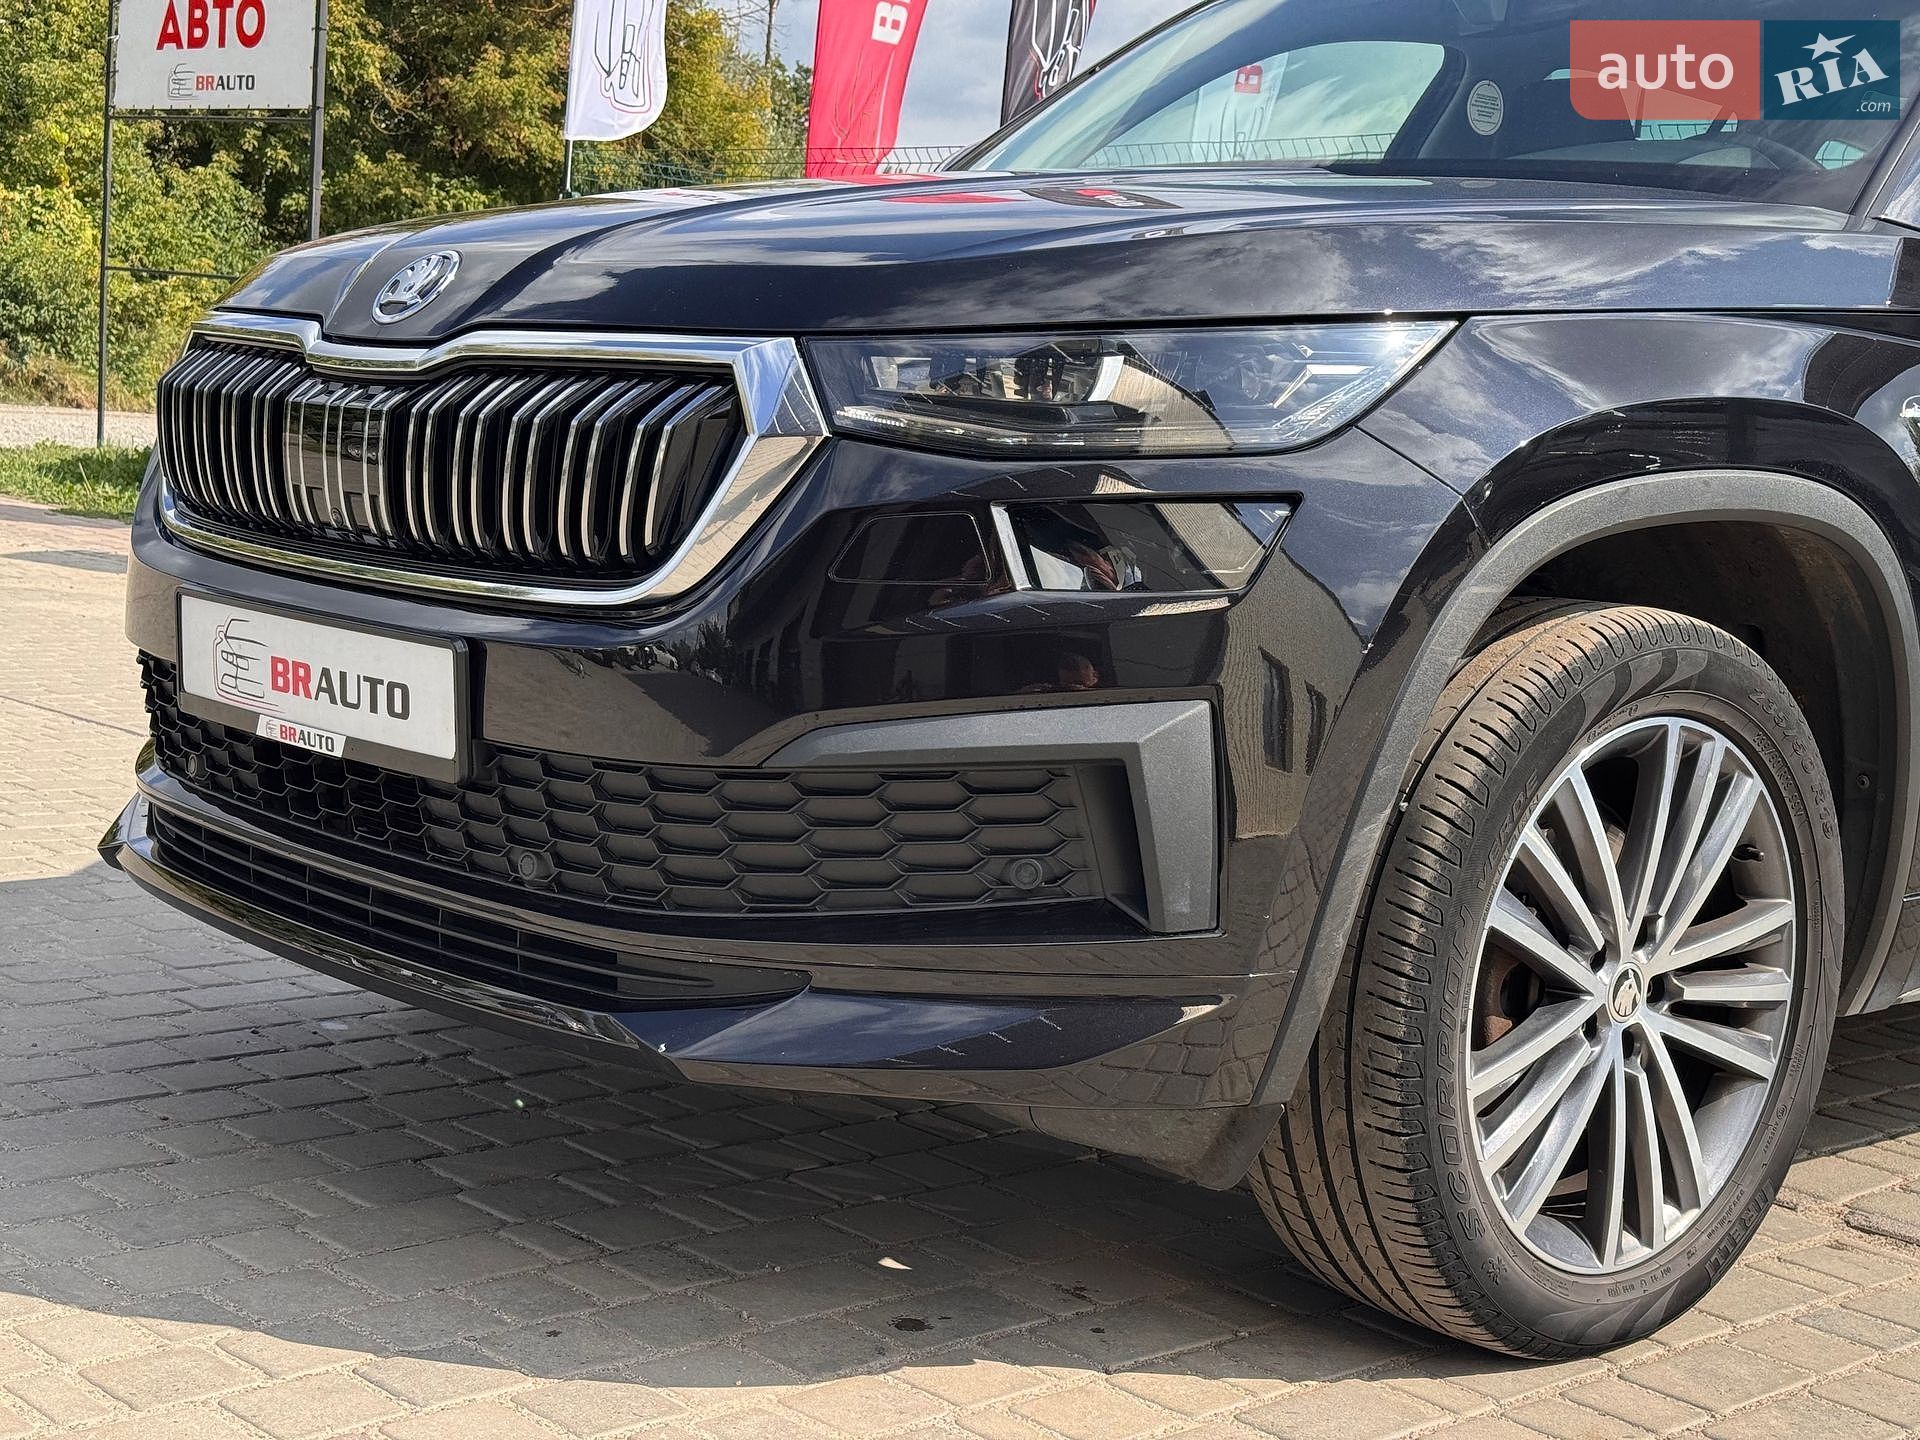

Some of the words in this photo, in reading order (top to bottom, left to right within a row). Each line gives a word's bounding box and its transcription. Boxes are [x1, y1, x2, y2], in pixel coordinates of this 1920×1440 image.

[871, 0, 911, 46] B
[195, 74, 256, 91] BRAUTO
[270, 655, 411, 721] BRAUTO
[279, 722, 335, 753] BRAUTO
[1436, 904, 1486, 1241] SCORPION
